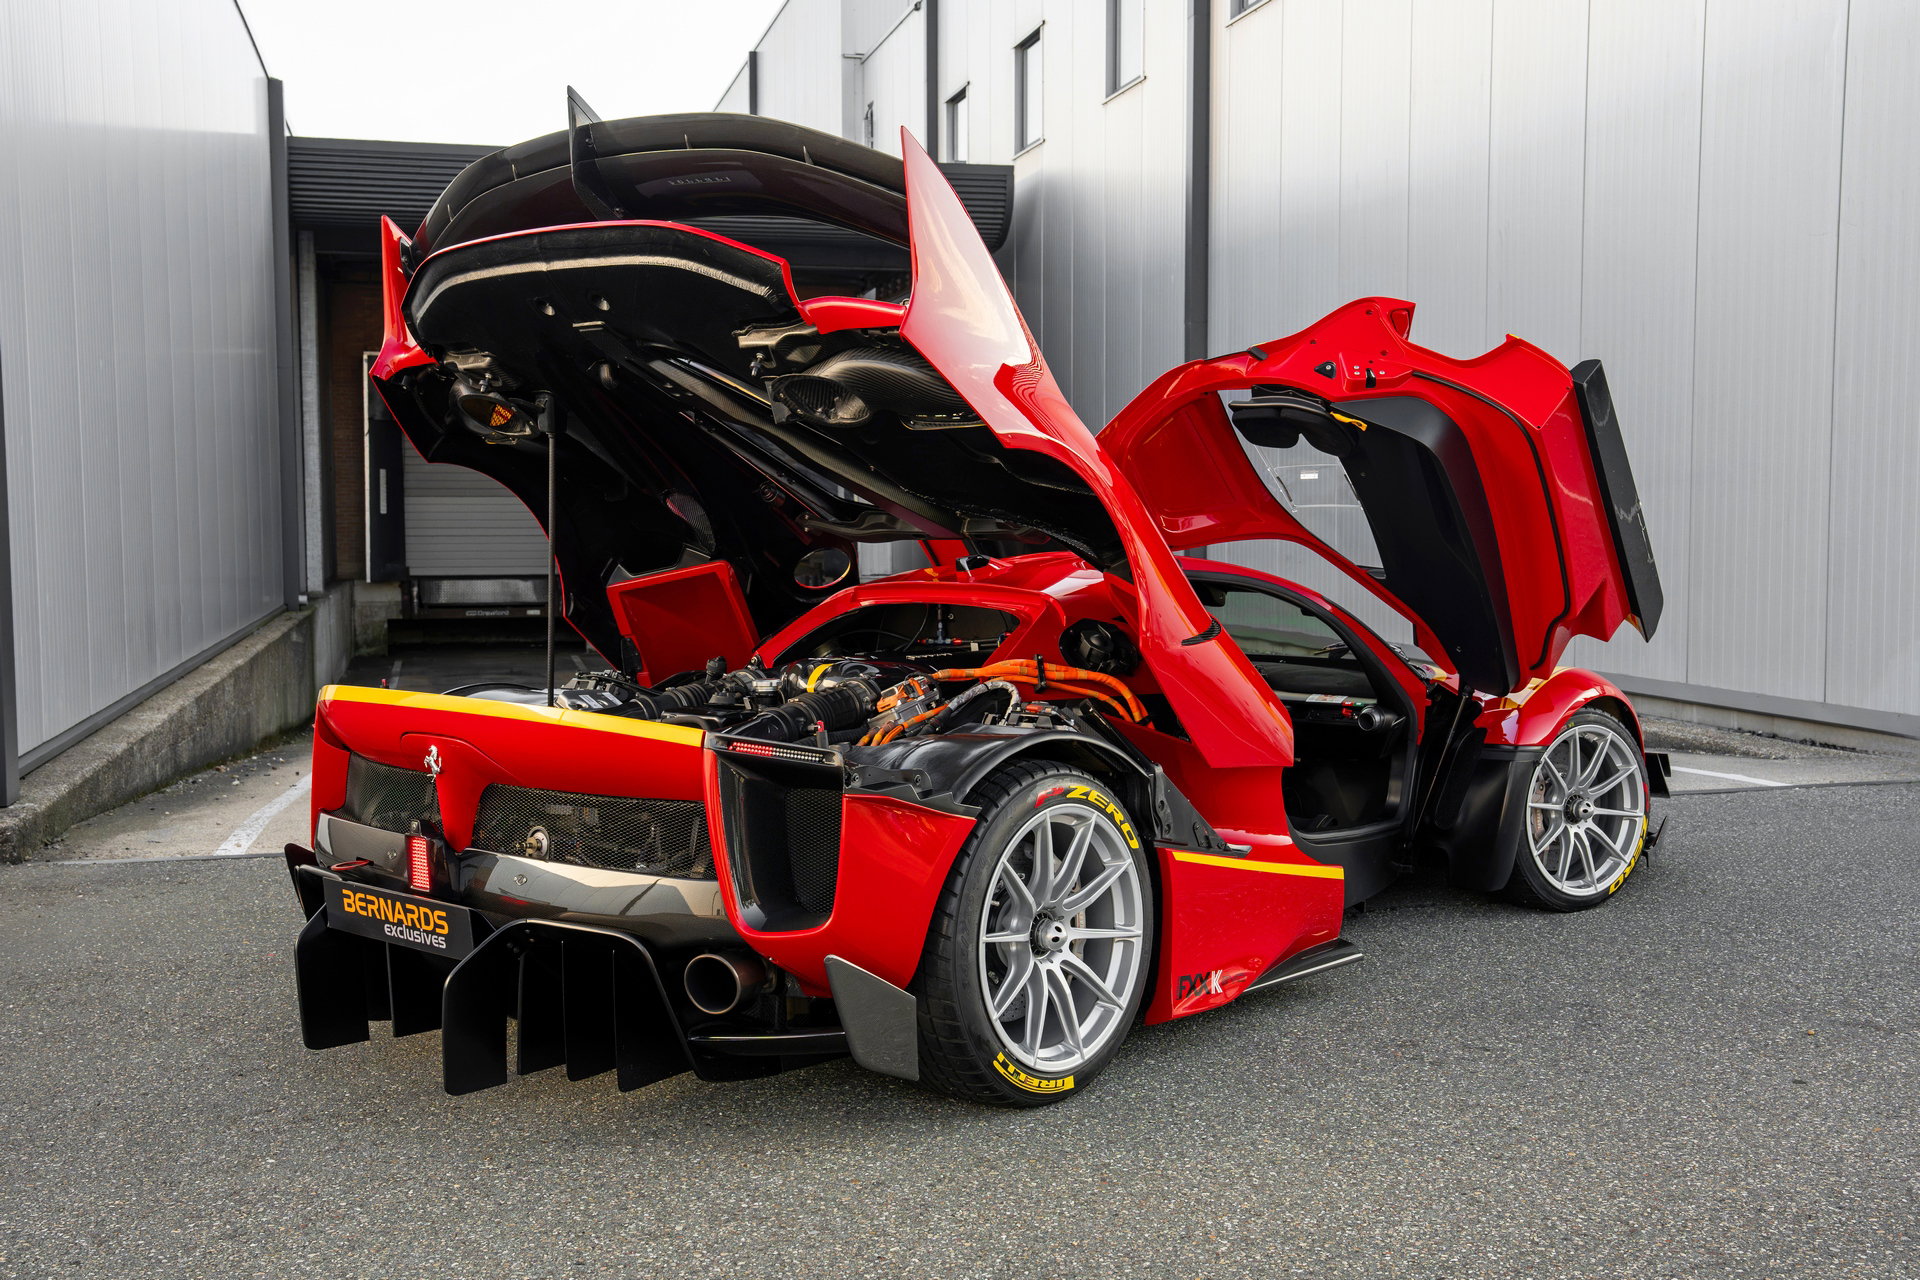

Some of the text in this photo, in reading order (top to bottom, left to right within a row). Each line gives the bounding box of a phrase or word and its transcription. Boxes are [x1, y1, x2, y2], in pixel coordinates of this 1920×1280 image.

[1066, 785, 1140, 849] ZERO
[342, 889, 449, 935] BERNARDS
[384, 923, 447, 949] exclusives
